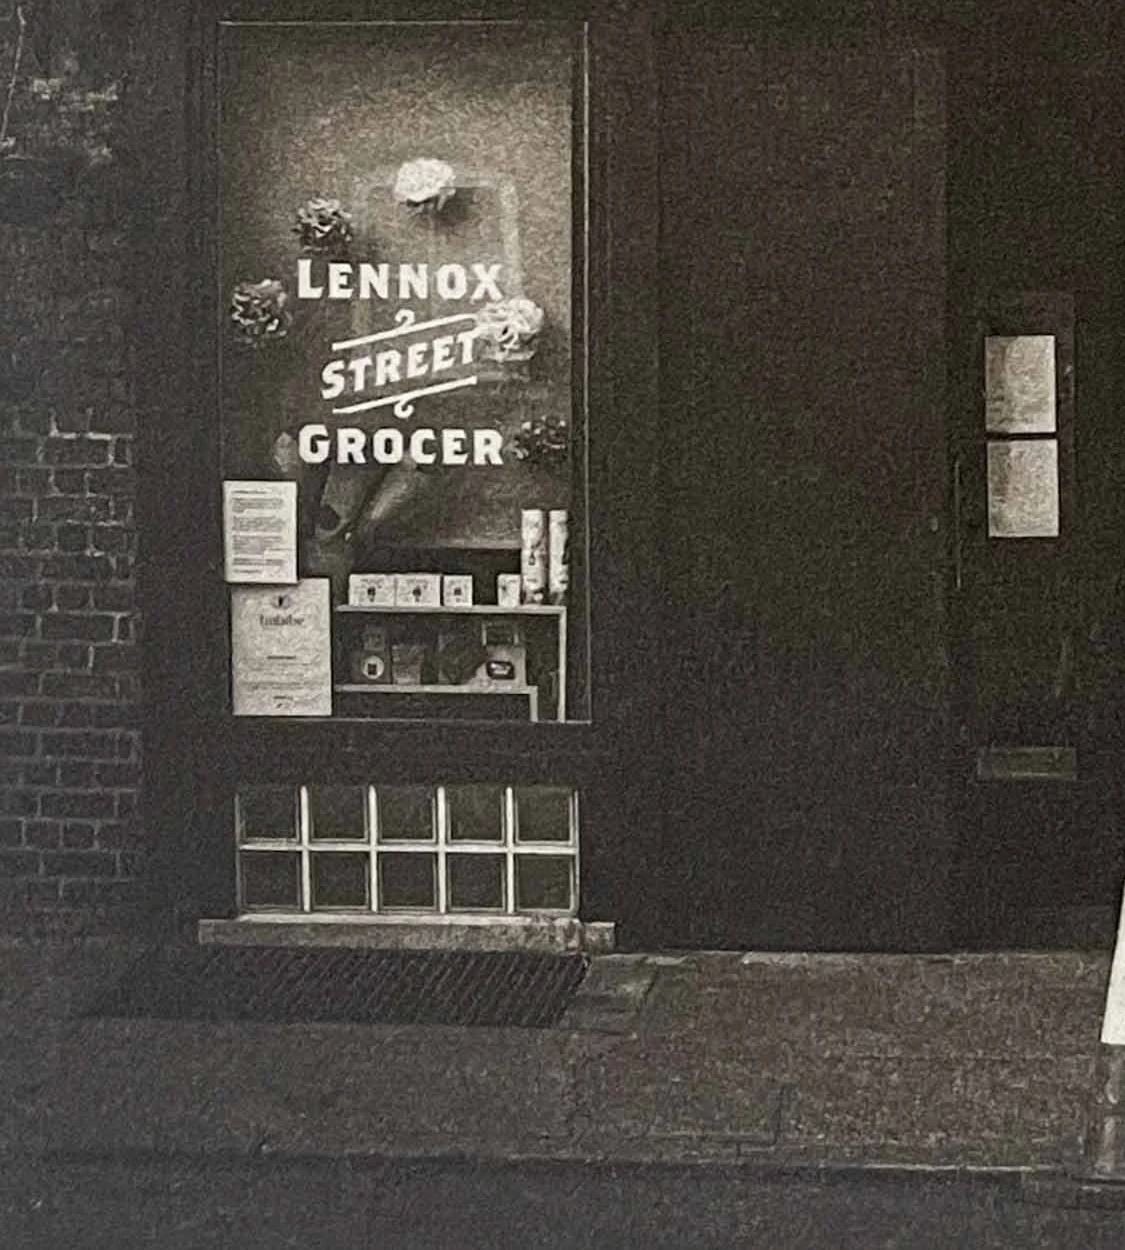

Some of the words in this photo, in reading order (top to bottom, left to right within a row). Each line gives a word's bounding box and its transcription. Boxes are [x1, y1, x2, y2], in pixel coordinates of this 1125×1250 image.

[297, 259, 503, 300] LENNOX
[320, 325, 484, 400] STREET
[299, 424, 504, 466] GROCER
